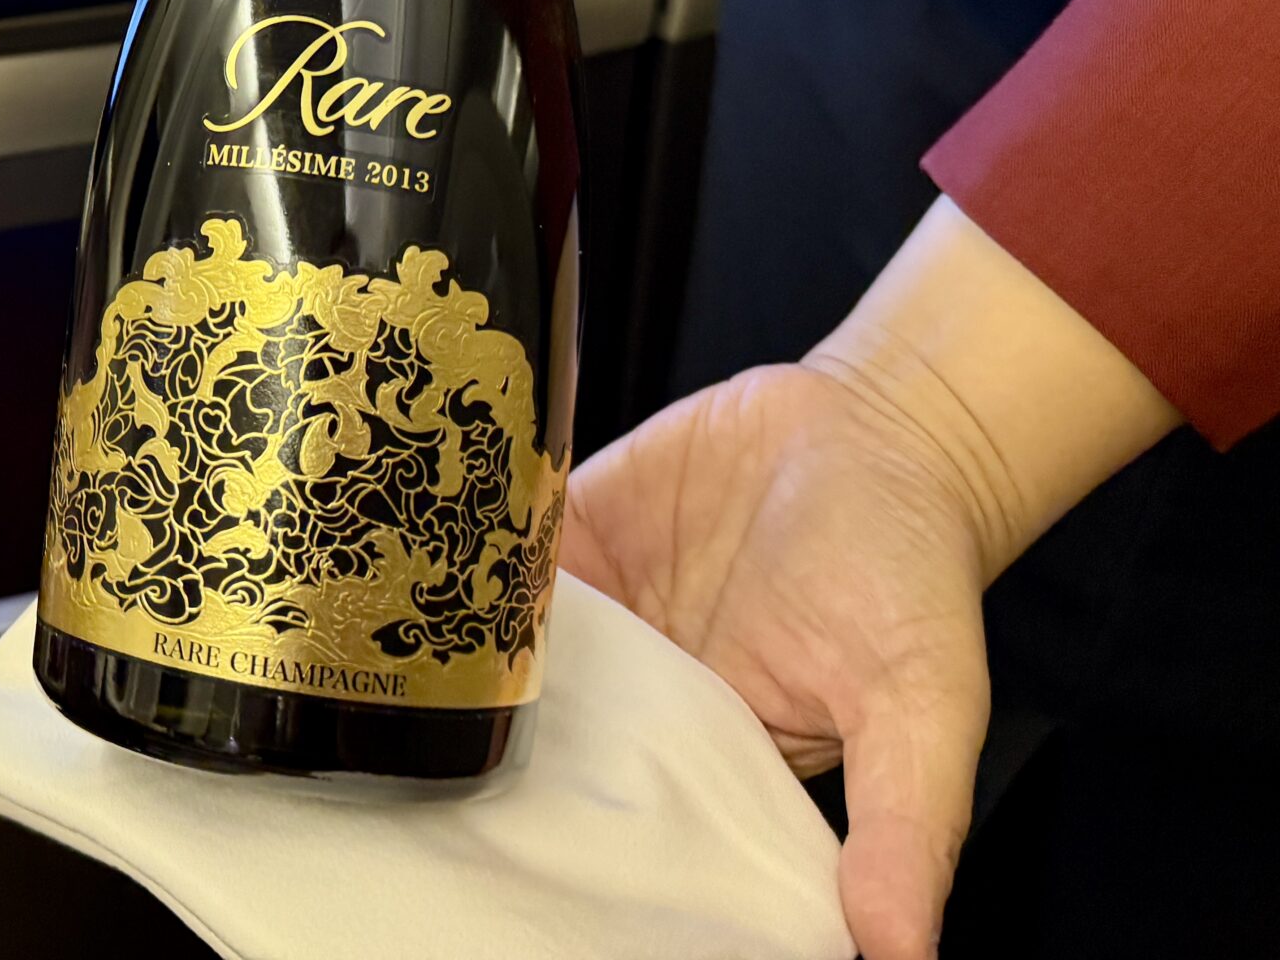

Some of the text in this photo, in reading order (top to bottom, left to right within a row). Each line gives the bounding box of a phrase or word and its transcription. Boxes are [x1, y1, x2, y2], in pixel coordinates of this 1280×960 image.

[202, 14, 452, 139] Rare
[206, 143, 430, 193] MILLÉSIME 2013
[152, 631, 407, 698] RARE CHAMPAGNE
